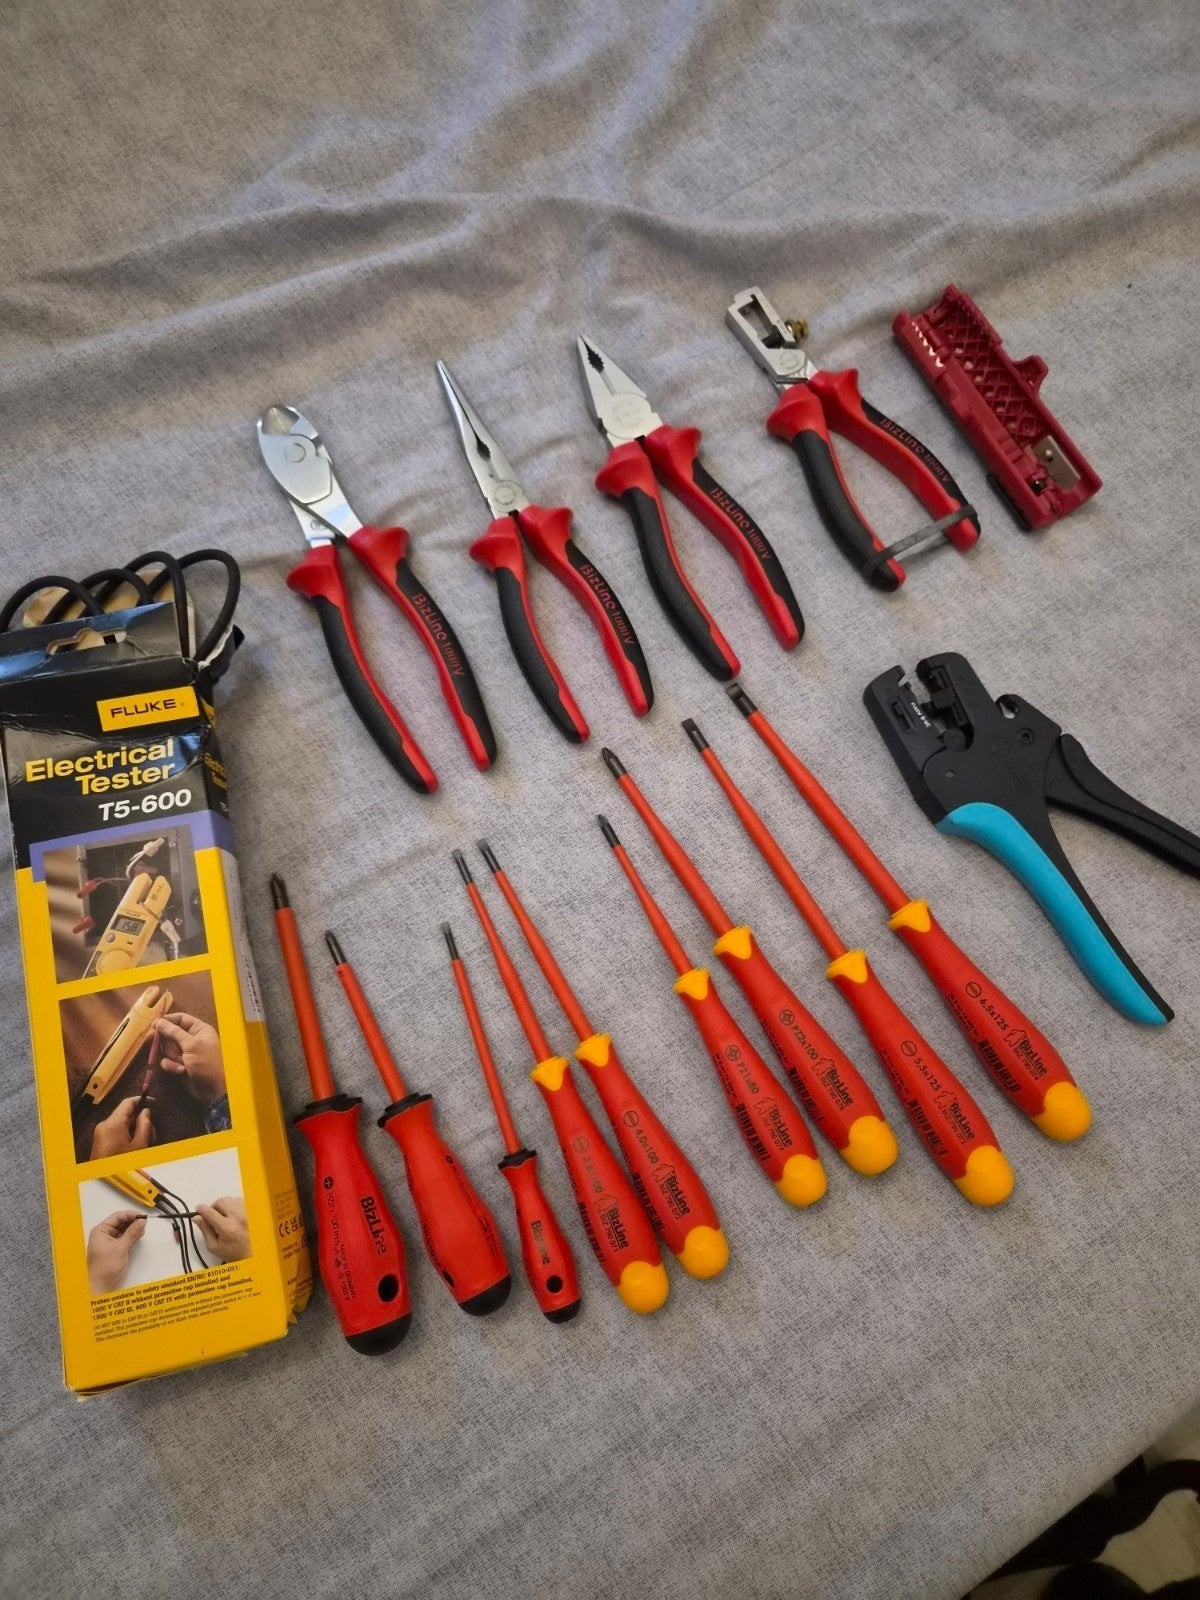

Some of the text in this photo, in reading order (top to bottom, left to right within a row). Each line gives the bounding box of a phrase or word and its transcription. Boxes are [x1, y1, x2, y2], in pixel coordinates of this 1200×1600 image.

[581, 564, 615, 611] BizLine
[412, 593, 446, 641] BizLine
[110, 698, 177, 718] FLUKE
[25, 739, 174, 782] Electrical
[75, 763, 175, 795] Tester
[98, 788, 192, 821] T5-600
[792, 1024, 818, 1060] PZ2x100
[1020, 1040, 1048, 1075] BizLine
[829, 1069, 853, 1106] BizLine
[769, 1109, 793, 1147] BizLine
[950, 1102, 975, 1140] BizLine
[666, 1175, 691, 1215] BizLine
[361, 1196, 387, 1255] BizLine
[607, 1206, 629, 1248] BizLine
